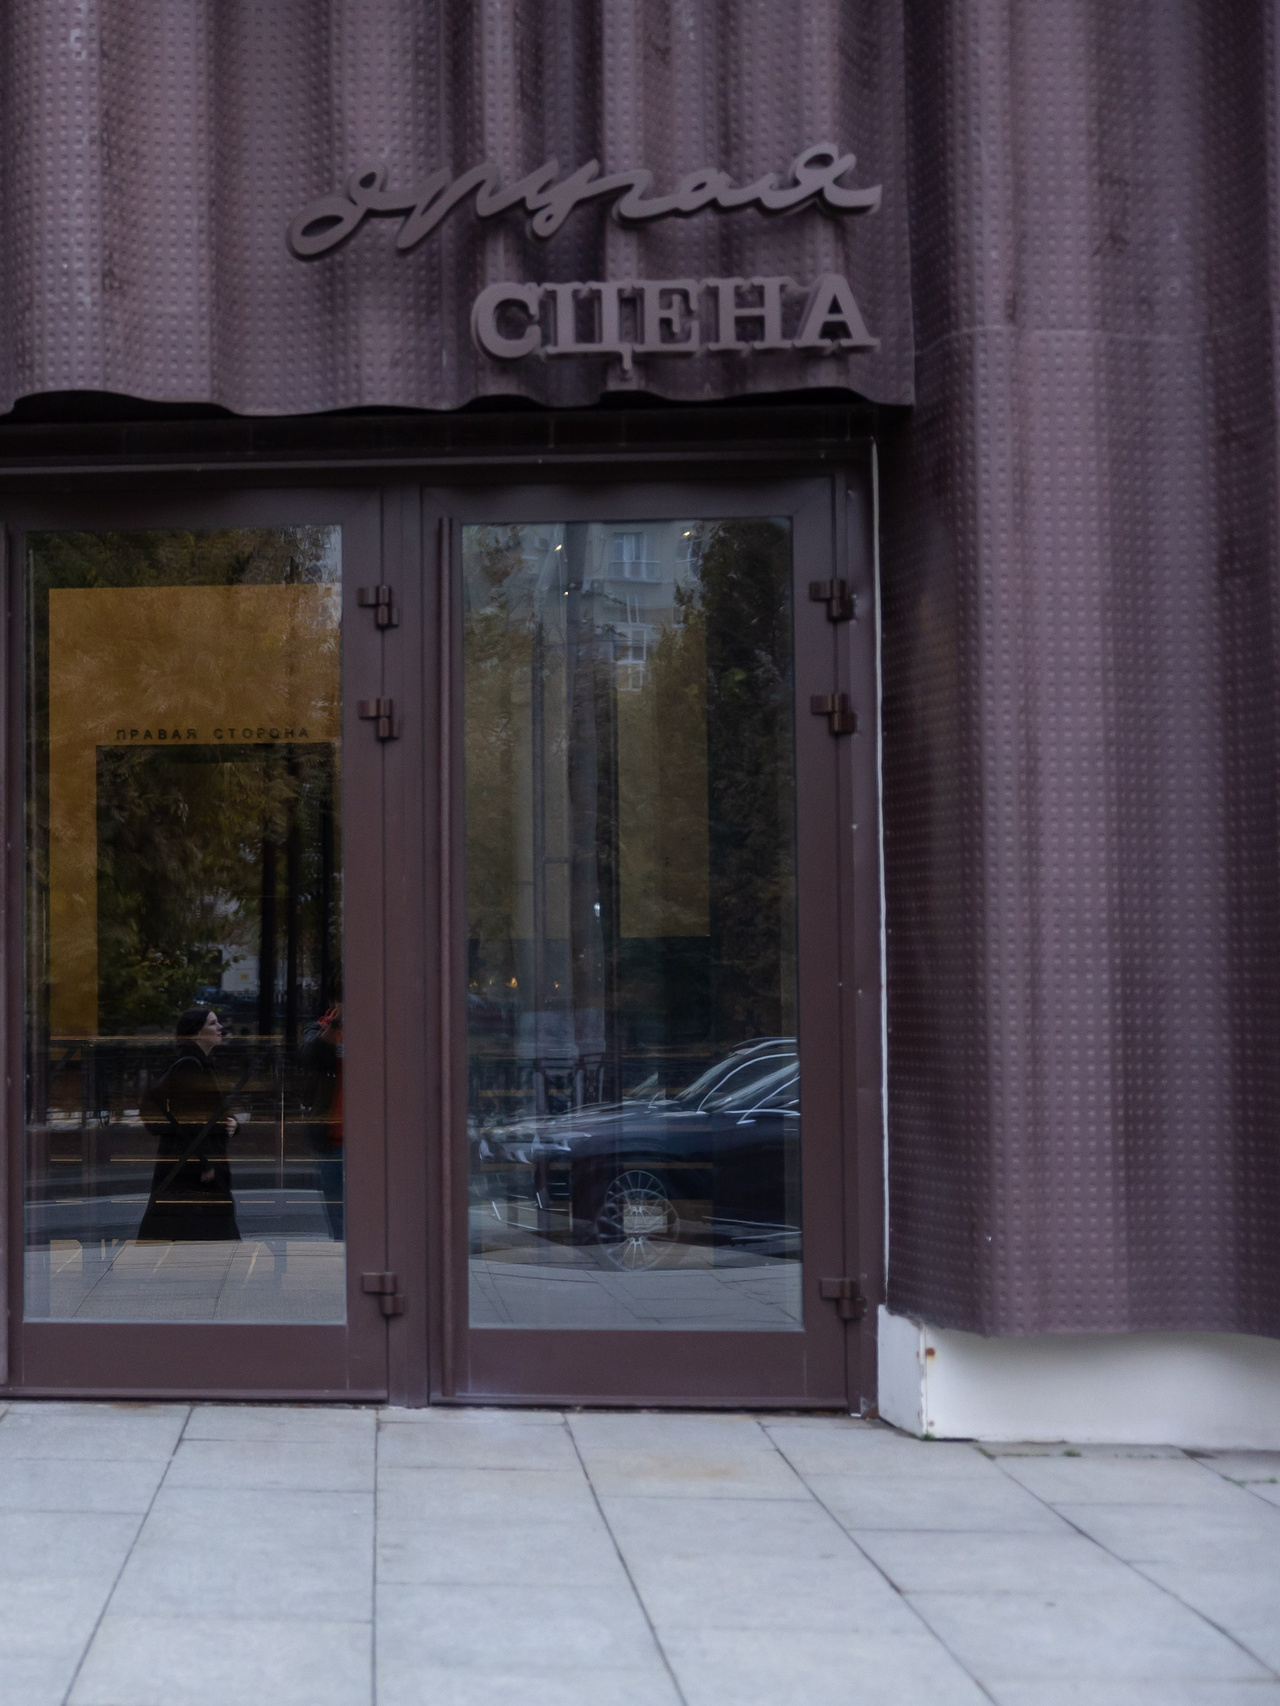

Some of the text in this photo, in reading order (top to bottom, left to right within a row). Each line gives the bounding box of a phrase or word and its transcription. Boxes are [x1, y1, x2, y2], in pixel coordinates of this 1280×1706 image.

[290, 142, 882, 256] другая
[472, 273, 881, 380] СЦЕНА
[116, 727, 310, 740] ПРАВАЯ СТОРОНА
